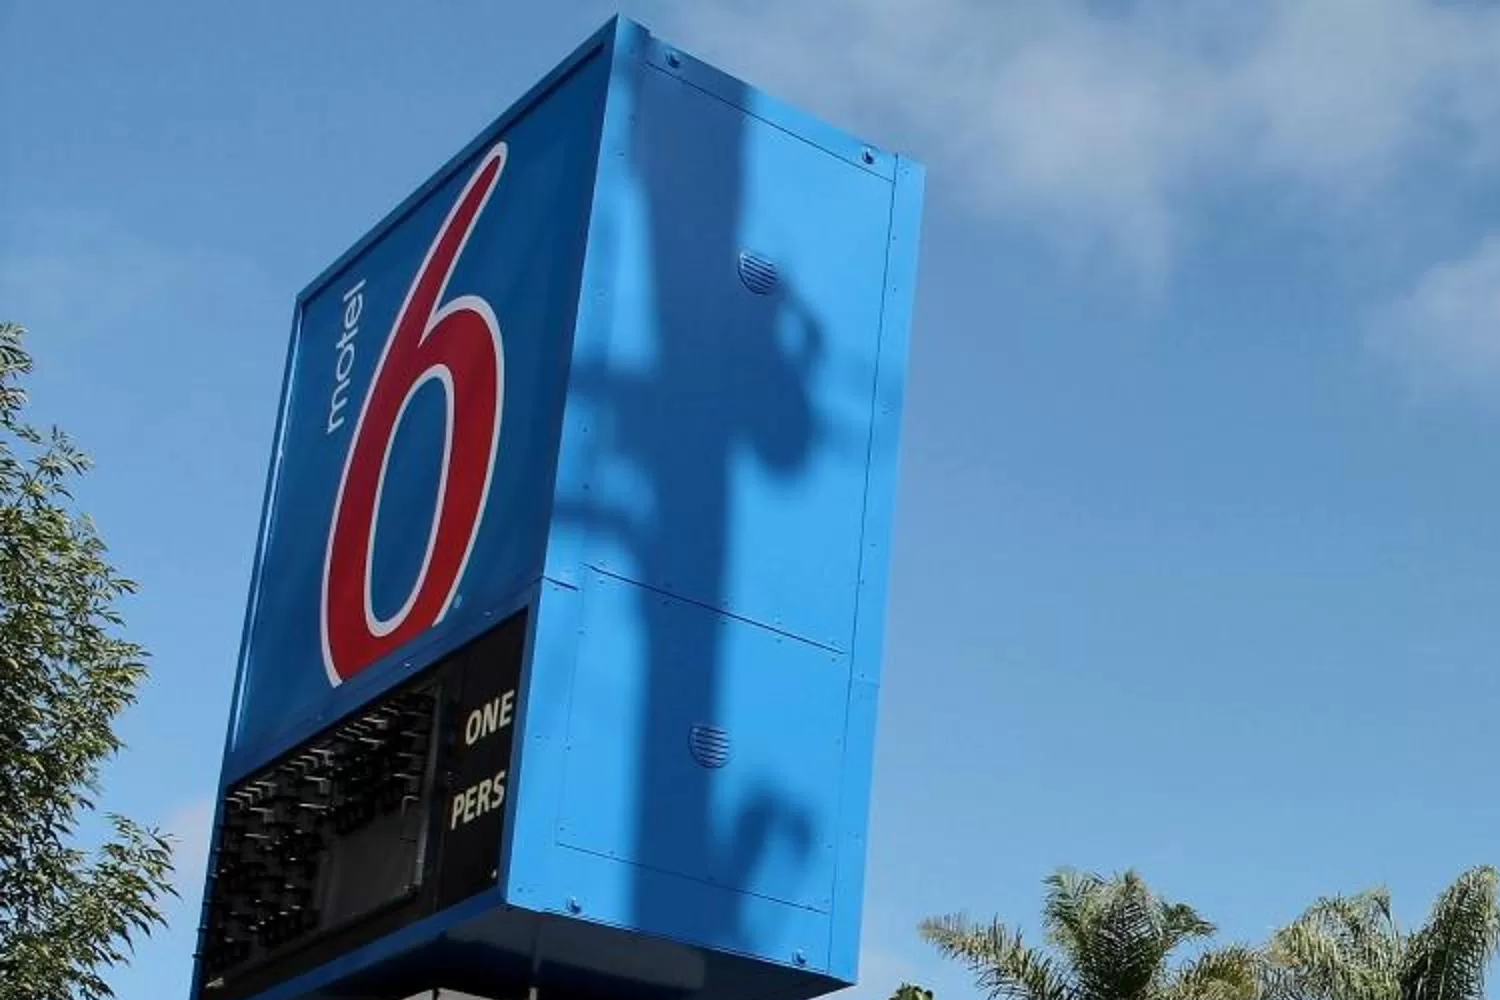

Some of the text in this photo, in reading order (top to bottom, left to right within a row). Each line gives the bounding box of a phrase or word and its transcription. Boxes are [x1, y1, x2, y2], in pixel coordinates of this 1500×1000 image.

[319, 141, 508, 688] motel 6
[465, 689, 514, 746] ONE
[450, 771, 506, 831] PERS
